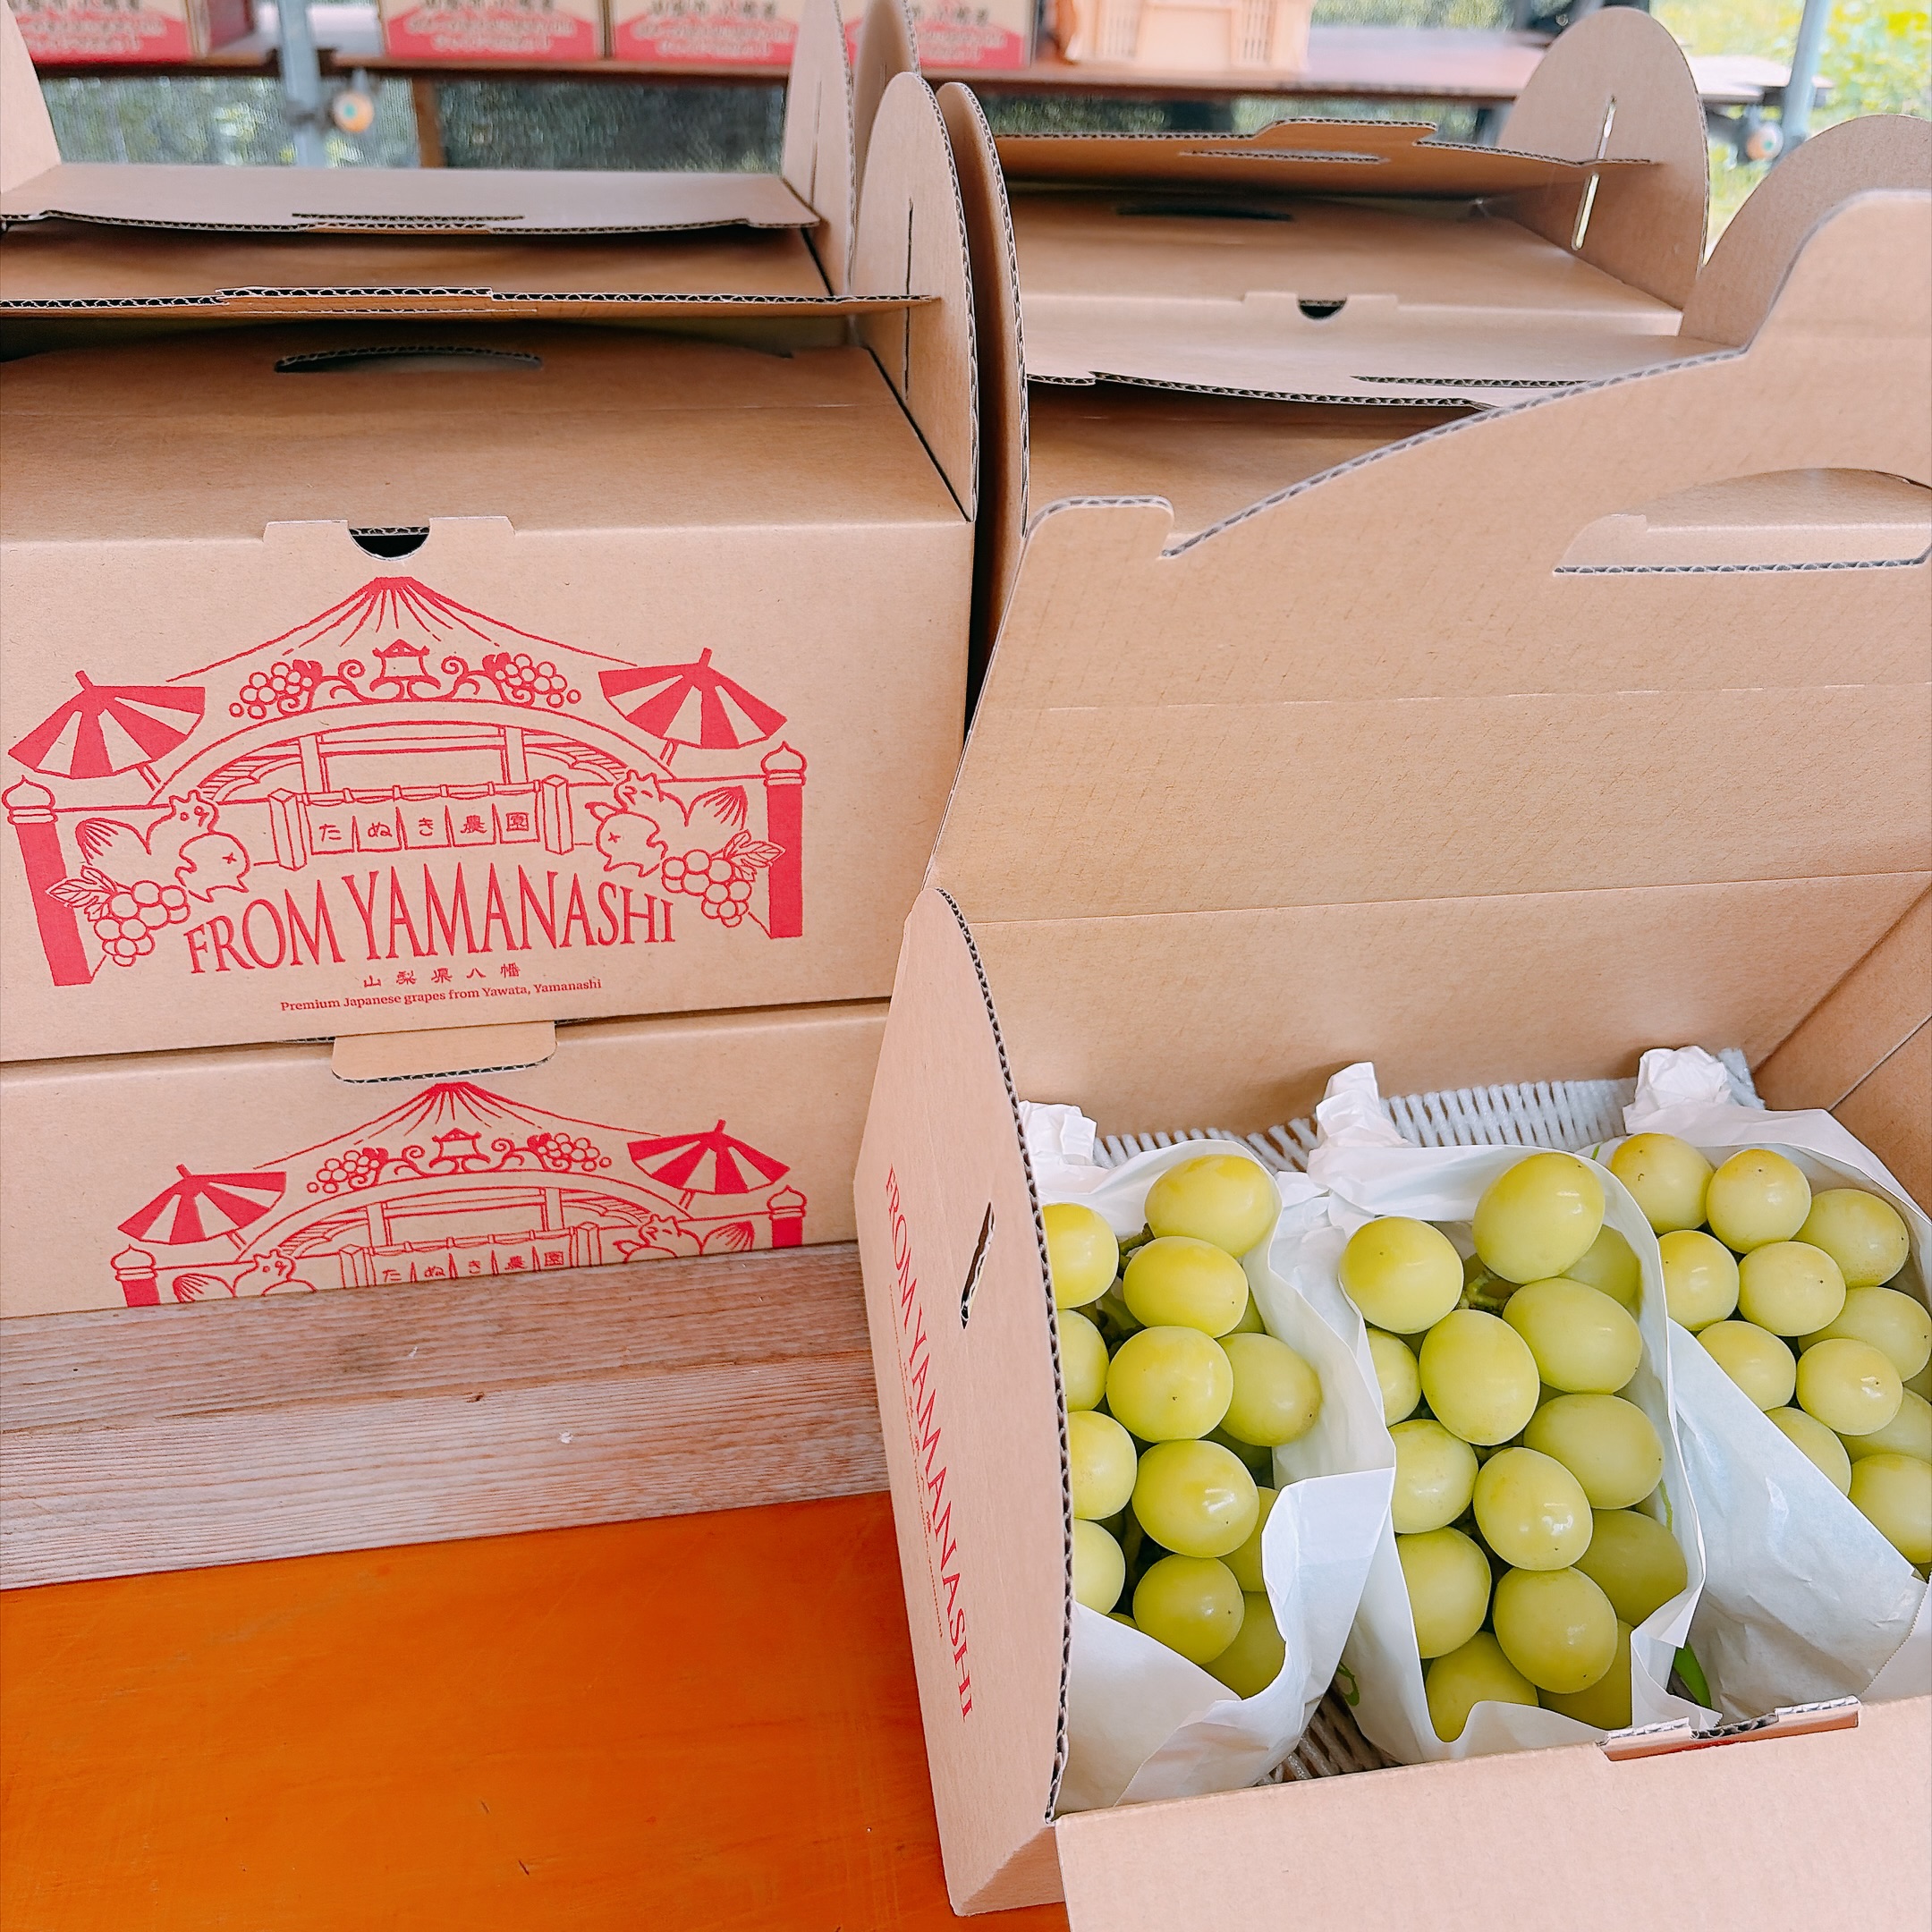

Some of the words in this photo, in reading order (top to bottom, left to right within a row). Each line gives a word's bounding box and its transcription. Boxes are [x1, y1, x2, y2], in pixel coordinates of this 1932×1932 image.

[318, 810, 530, 843] たぬき農園
[182, 878, 347, 975] FROM
[340, 861, 677, 962] YAMANASHI
[362, 962, 521, 988] 山梨県八幡
[280, 998, 341, 1012] Premium
[343, 995, 402, 1009] Japanese
[403, 991, 446, 1005] grapes
[448, 987, 480, 1000] from
[481, 986, 531, 997] Yawata,
[533, 979, 602, 993] Yamanashi
[381, 1250, 564, 1283] たぬき農園
[884, 1164, 918, 1334] FROM
[908, 1303, 973, 1723] YAMANASHI
